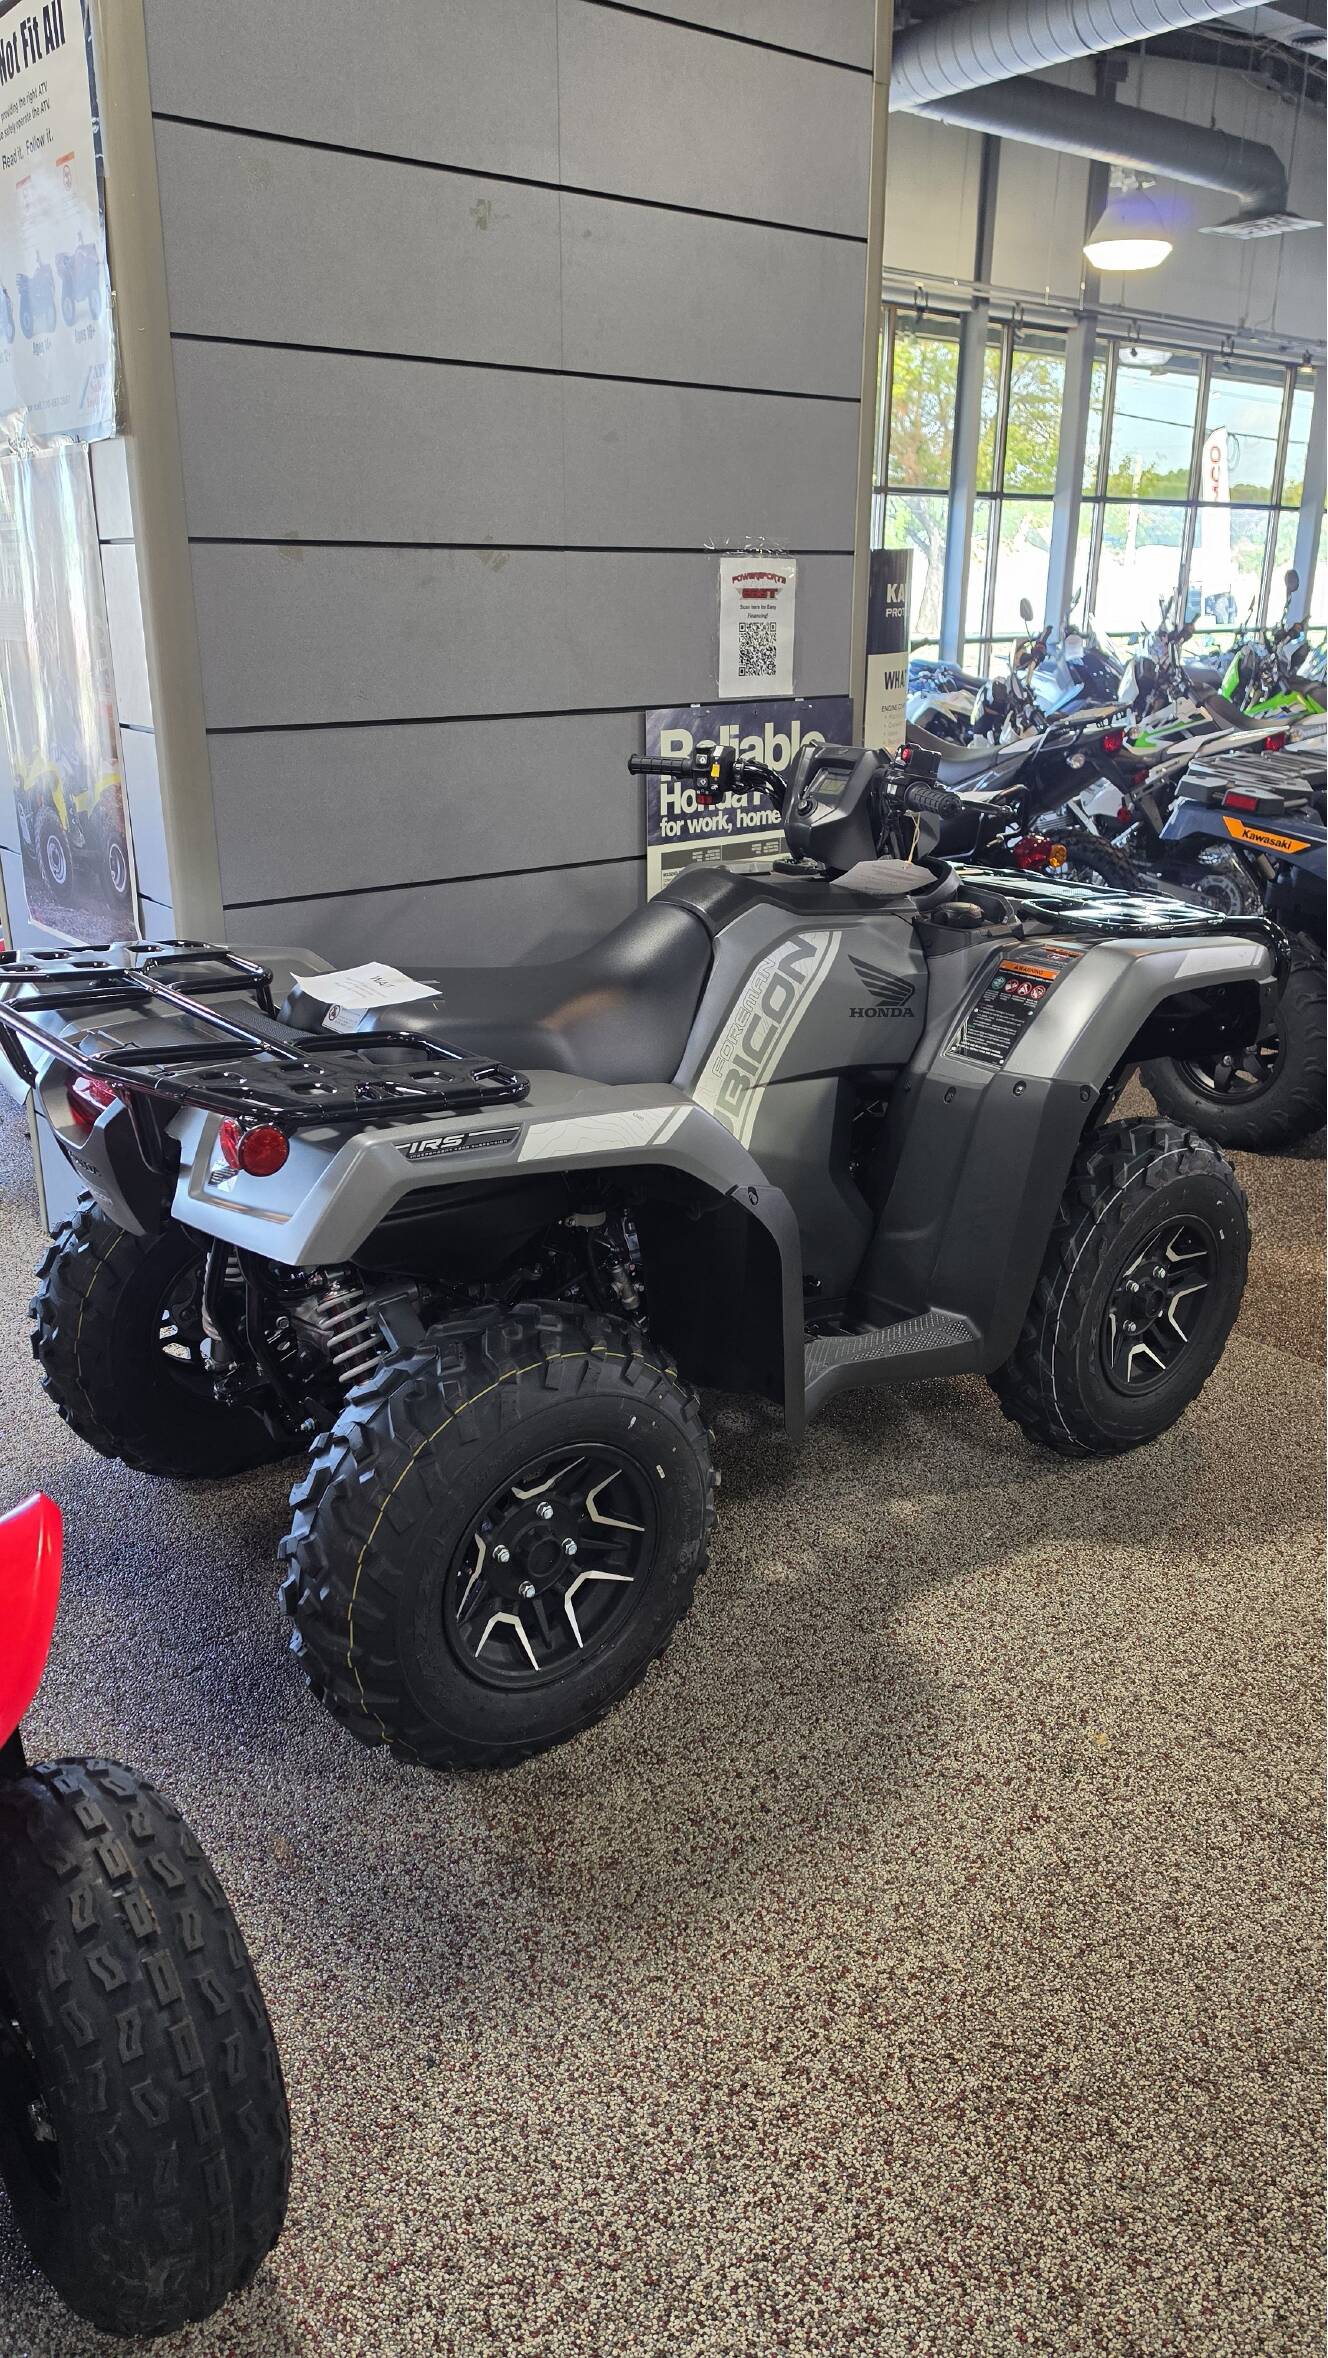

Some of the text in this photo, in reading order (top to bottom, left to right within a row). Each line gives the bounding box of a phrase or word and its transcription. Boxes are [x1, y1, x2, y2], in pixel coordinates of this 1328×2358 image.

[20, 16, 43, 69] Fit
[43, 0, 66, 55] All
[38, 81, 48, 97] ATV
[2, 147, 18, 170] Read
[26, 134, 45, 155] Follow
[660, 808, 782, 837] for work, home
[1241, 828, 1293, 850] Kawasaki
[712, 957, 776, 1078] FOREMAN
[849, 1007, 916, 1018] HONDA
[408, 1134, 465, 1153] IRS
